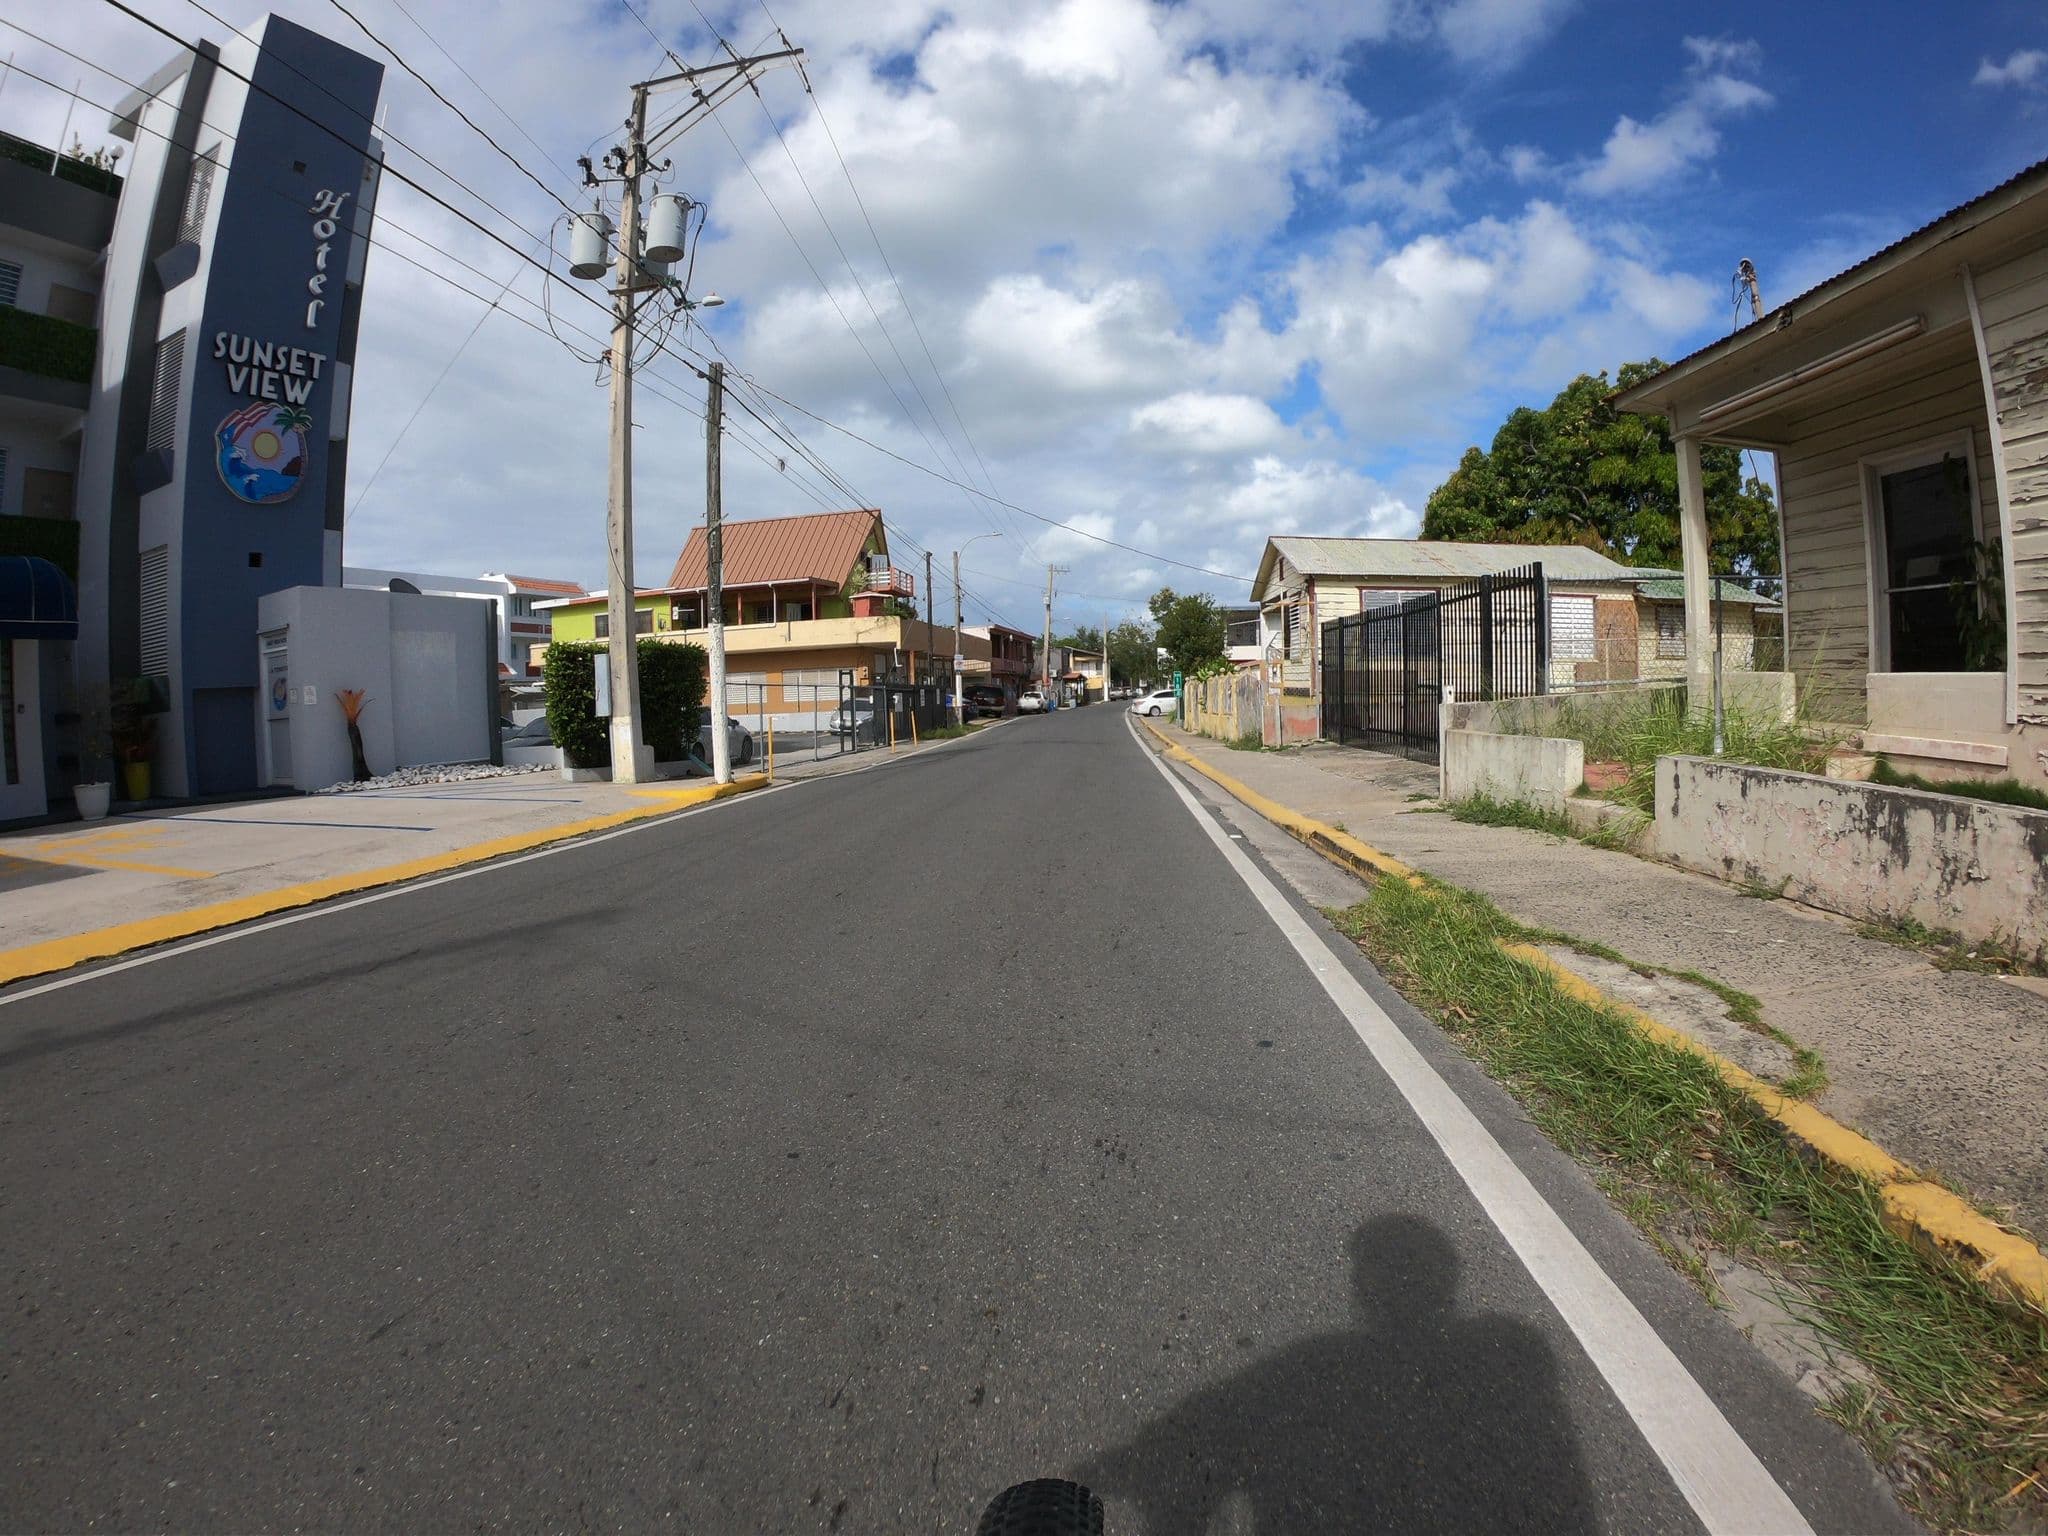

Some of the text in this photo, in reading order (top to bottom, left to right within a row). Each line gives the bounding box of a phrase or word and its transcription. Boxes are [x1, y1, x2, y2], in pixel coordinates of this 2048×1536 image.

[307, 189, 351, 328] Hotel
[214, 331, 327, 379] SUNSET
[227, 363, 314, 405] VIEW
